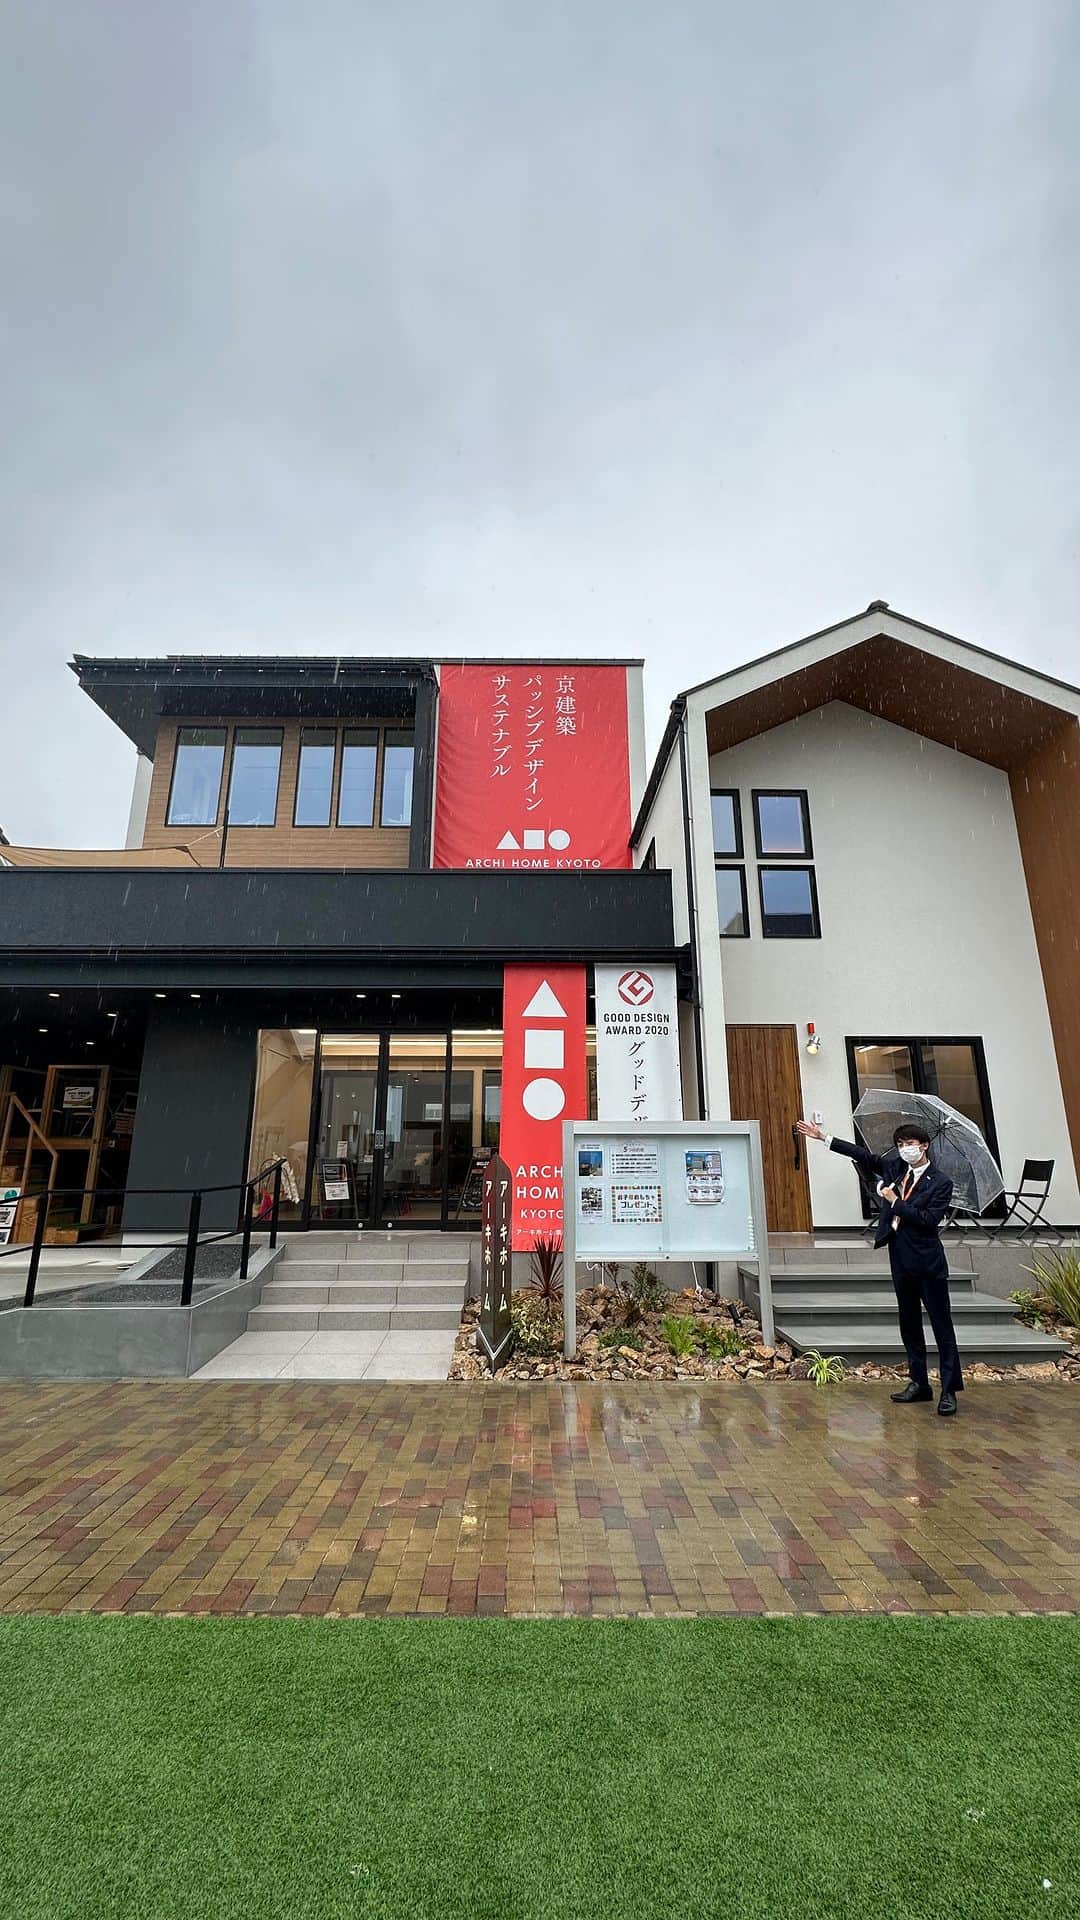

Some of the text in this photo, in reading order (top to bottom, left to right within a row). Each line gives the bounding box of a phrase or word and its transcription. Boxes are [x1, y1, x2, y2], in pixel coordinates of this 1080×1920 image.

[555, 675, 577, 736] 京建築
[489, 675, 512, 778] サステナブル
[522, 674, 545, 811] パッシブデザイン
[465, 858, 601, 868] ARCHI HOME KYOTO
[603, 1013, 670, 1023] GOOD DESIGN
[605, 1026, 669, 1036] AWARD 2020
[516, 1165, 563, 1178] ARCH
[516, 1186, 564, 1199] HOM
[484, 1180, 492, 1312] アーキホーム
[500, 1180, 508, 1312] アーキホーム
